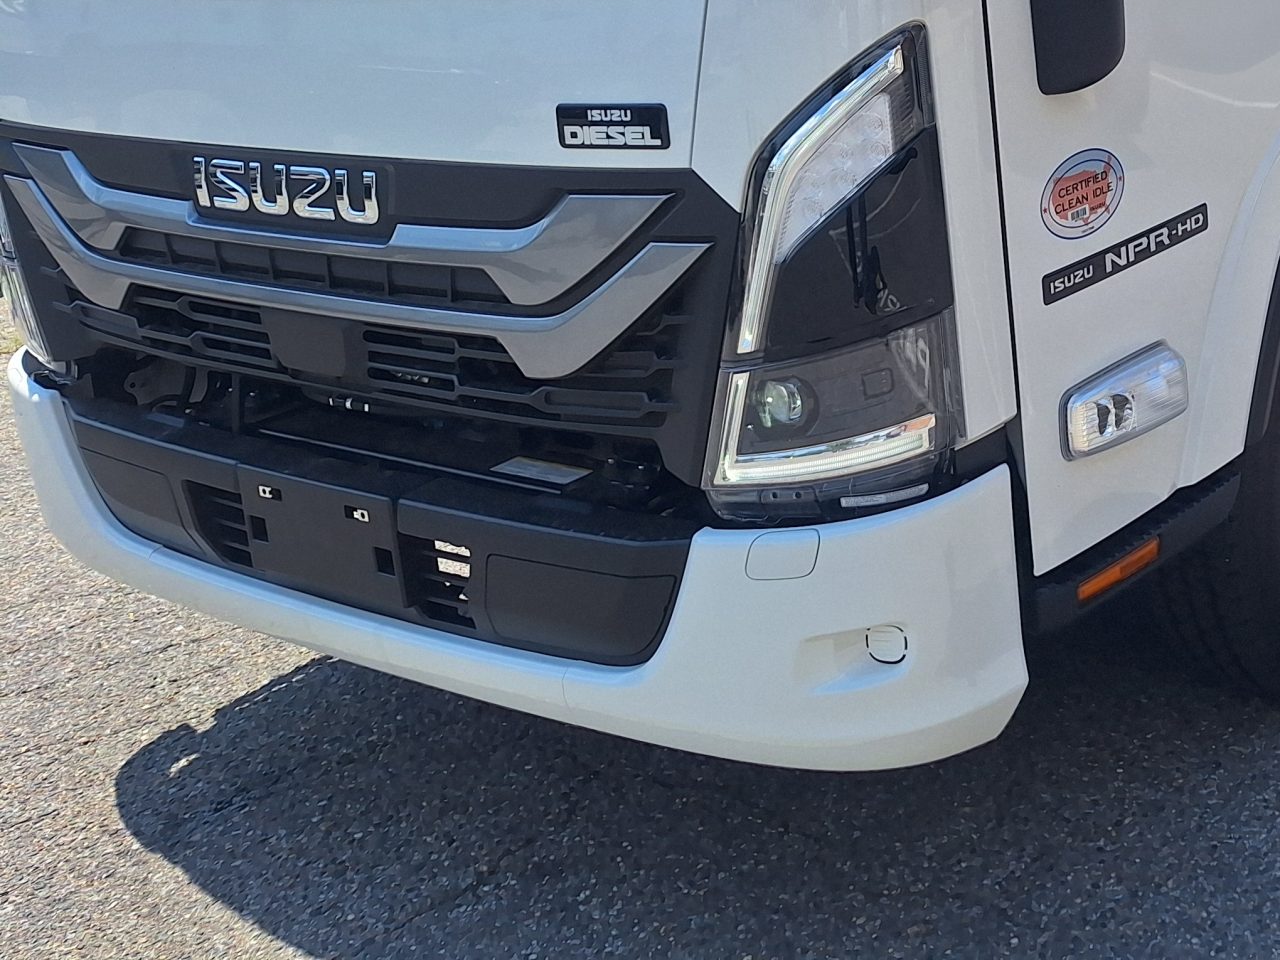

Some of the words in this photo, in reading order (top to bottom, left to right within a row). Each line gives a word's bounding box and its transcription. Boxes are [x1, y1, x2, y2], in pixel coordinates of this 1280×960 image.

[587, 108, 631, 122] ISUZU
[563, 125, 662, 146] DIESEL
[193, 156, 379, 225] ISUZU
[1054, 192, 1089, 215] CLEAN
[1092, 181, 1114, 199] IDLE
[1058, 170, 1108, 198] CERTIFIED
[1050, 265, 1093, 295] ISUZU
[1104, 213, 1204, 273] NPR-HD
